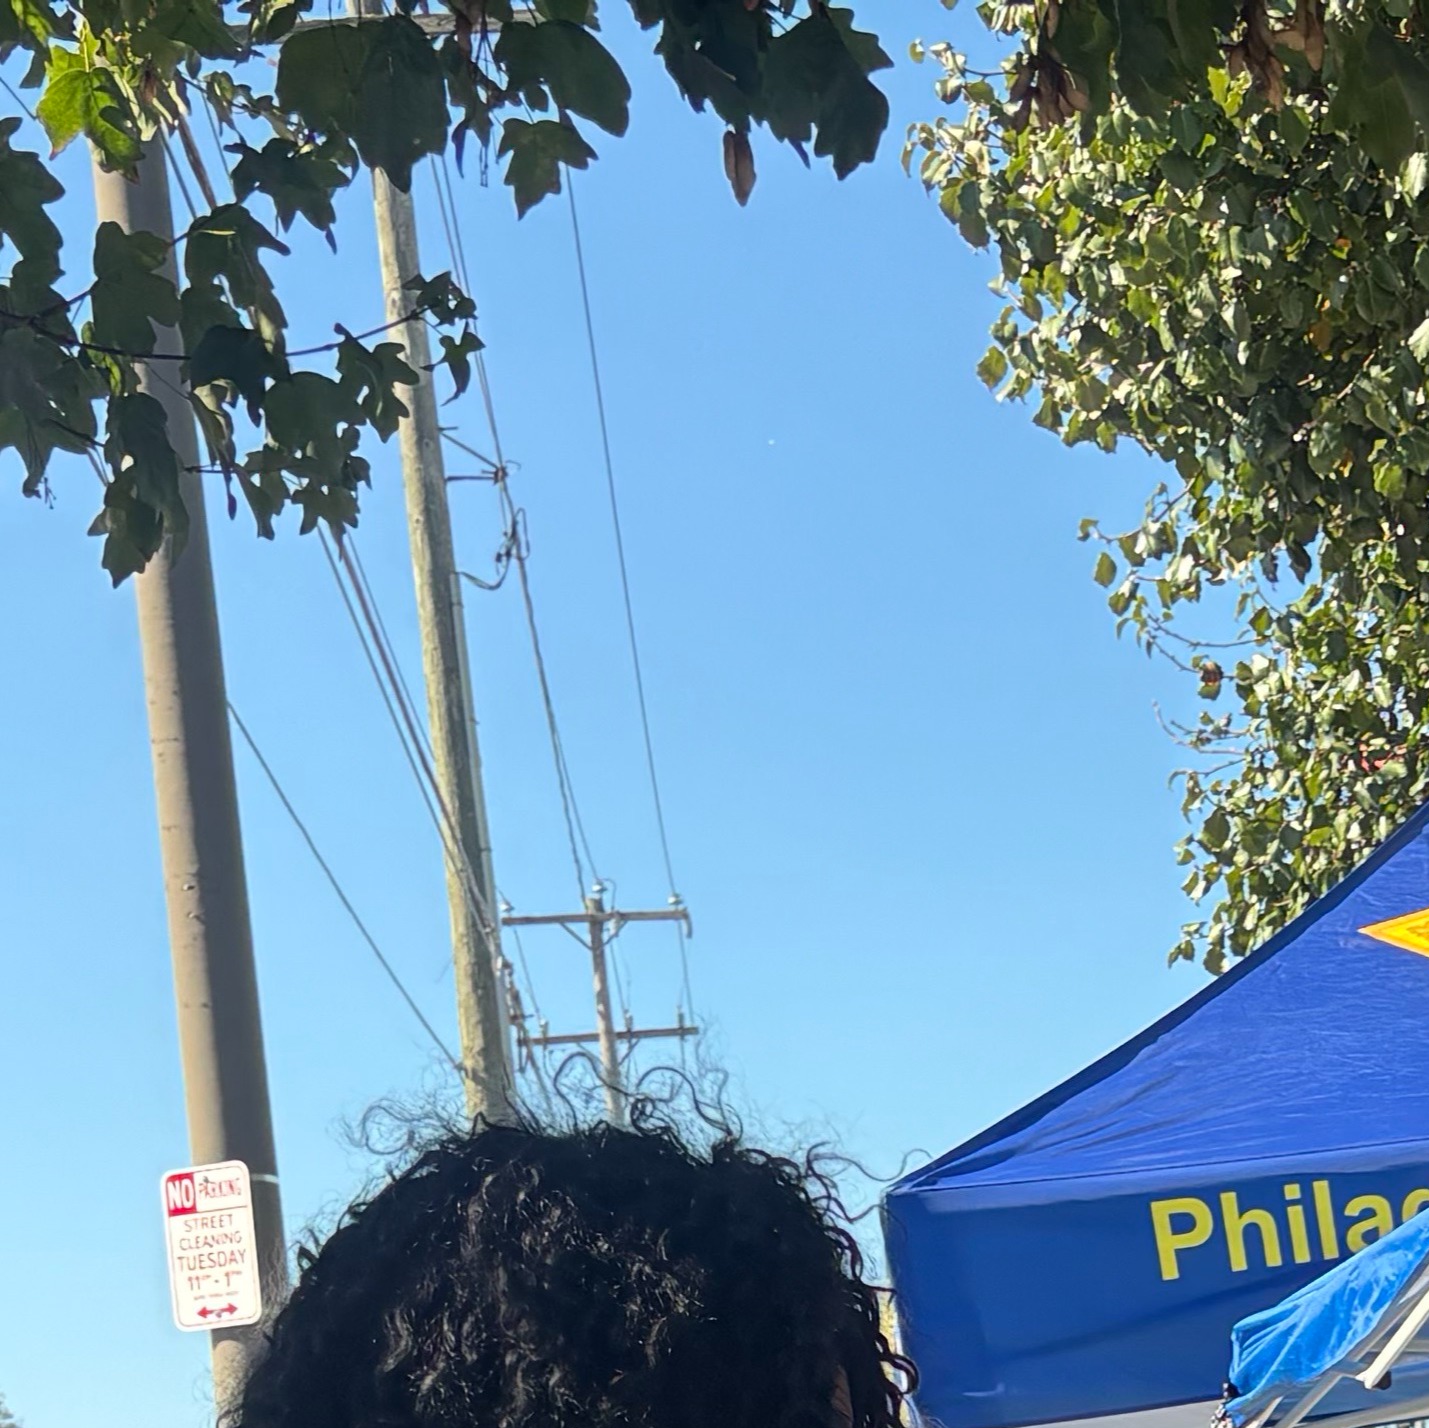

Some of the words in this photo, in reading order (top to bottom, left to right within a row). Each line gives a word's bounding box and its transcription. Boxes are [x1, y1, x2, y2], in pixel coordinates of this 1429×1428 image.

[166, 1178, 195, 1211] NO
[199, 1178, 242, 1198] PARKING
[184, 1214, 233, 1232] STREET
[179, 1231, 242, 1251] CLEANING
[177, 1249, 246, 1273] TUESDAY
